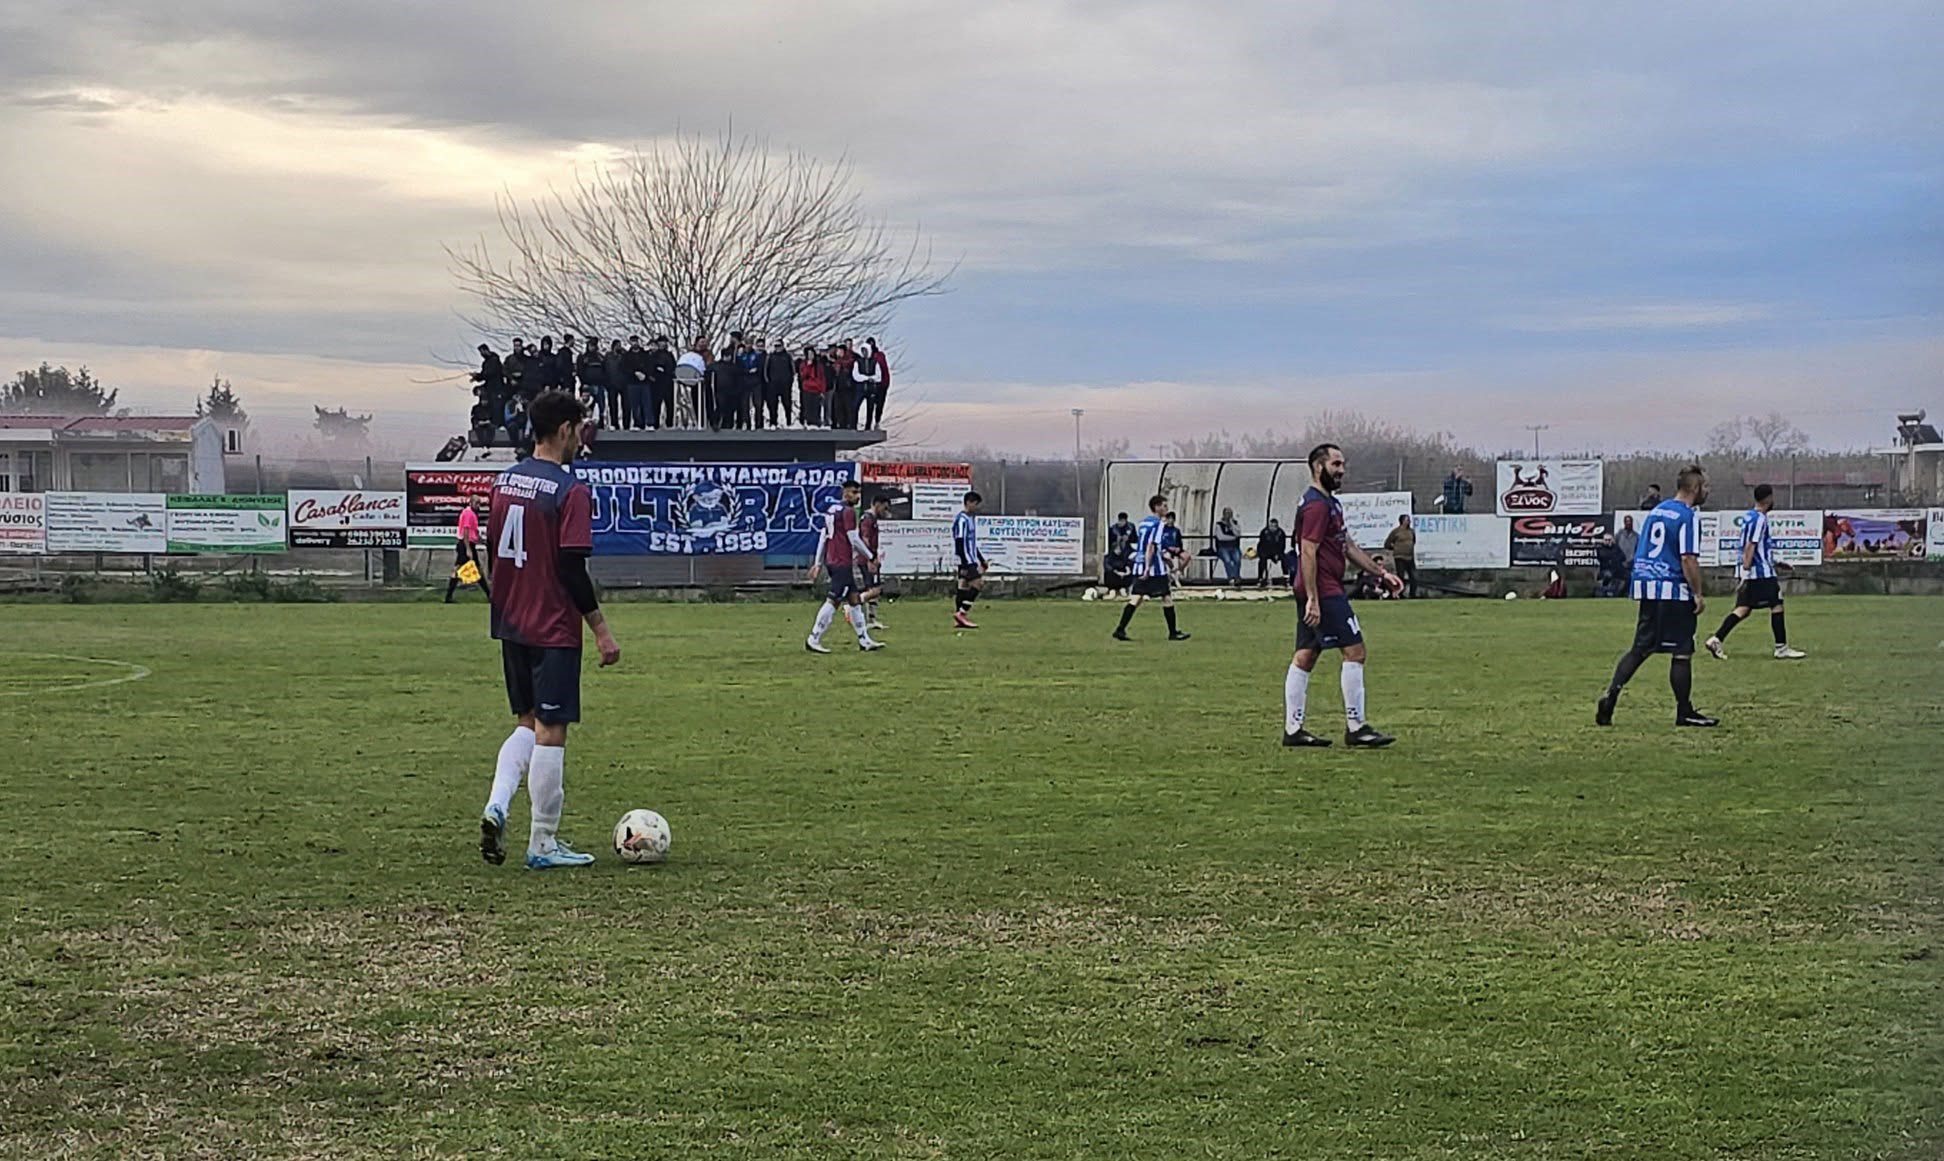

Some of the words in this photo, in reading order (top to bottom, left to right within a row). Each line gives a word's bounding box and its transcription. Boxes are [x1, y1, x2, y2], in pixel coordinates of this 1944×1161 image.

[575, 467, 714, 484] PROODEUTIKI
[720, 467, 848, 486] MANOLADAS
[0, 497, 42, 510] ΛΕΙΟ
[295, 493, 400, 523] Casablanca
[498, 504, 527, 568] 4
[1413, 517, 1467, 532] ΡΔΕΥΤΙΚΗ
[1648, 521, 1666, 559] 9
